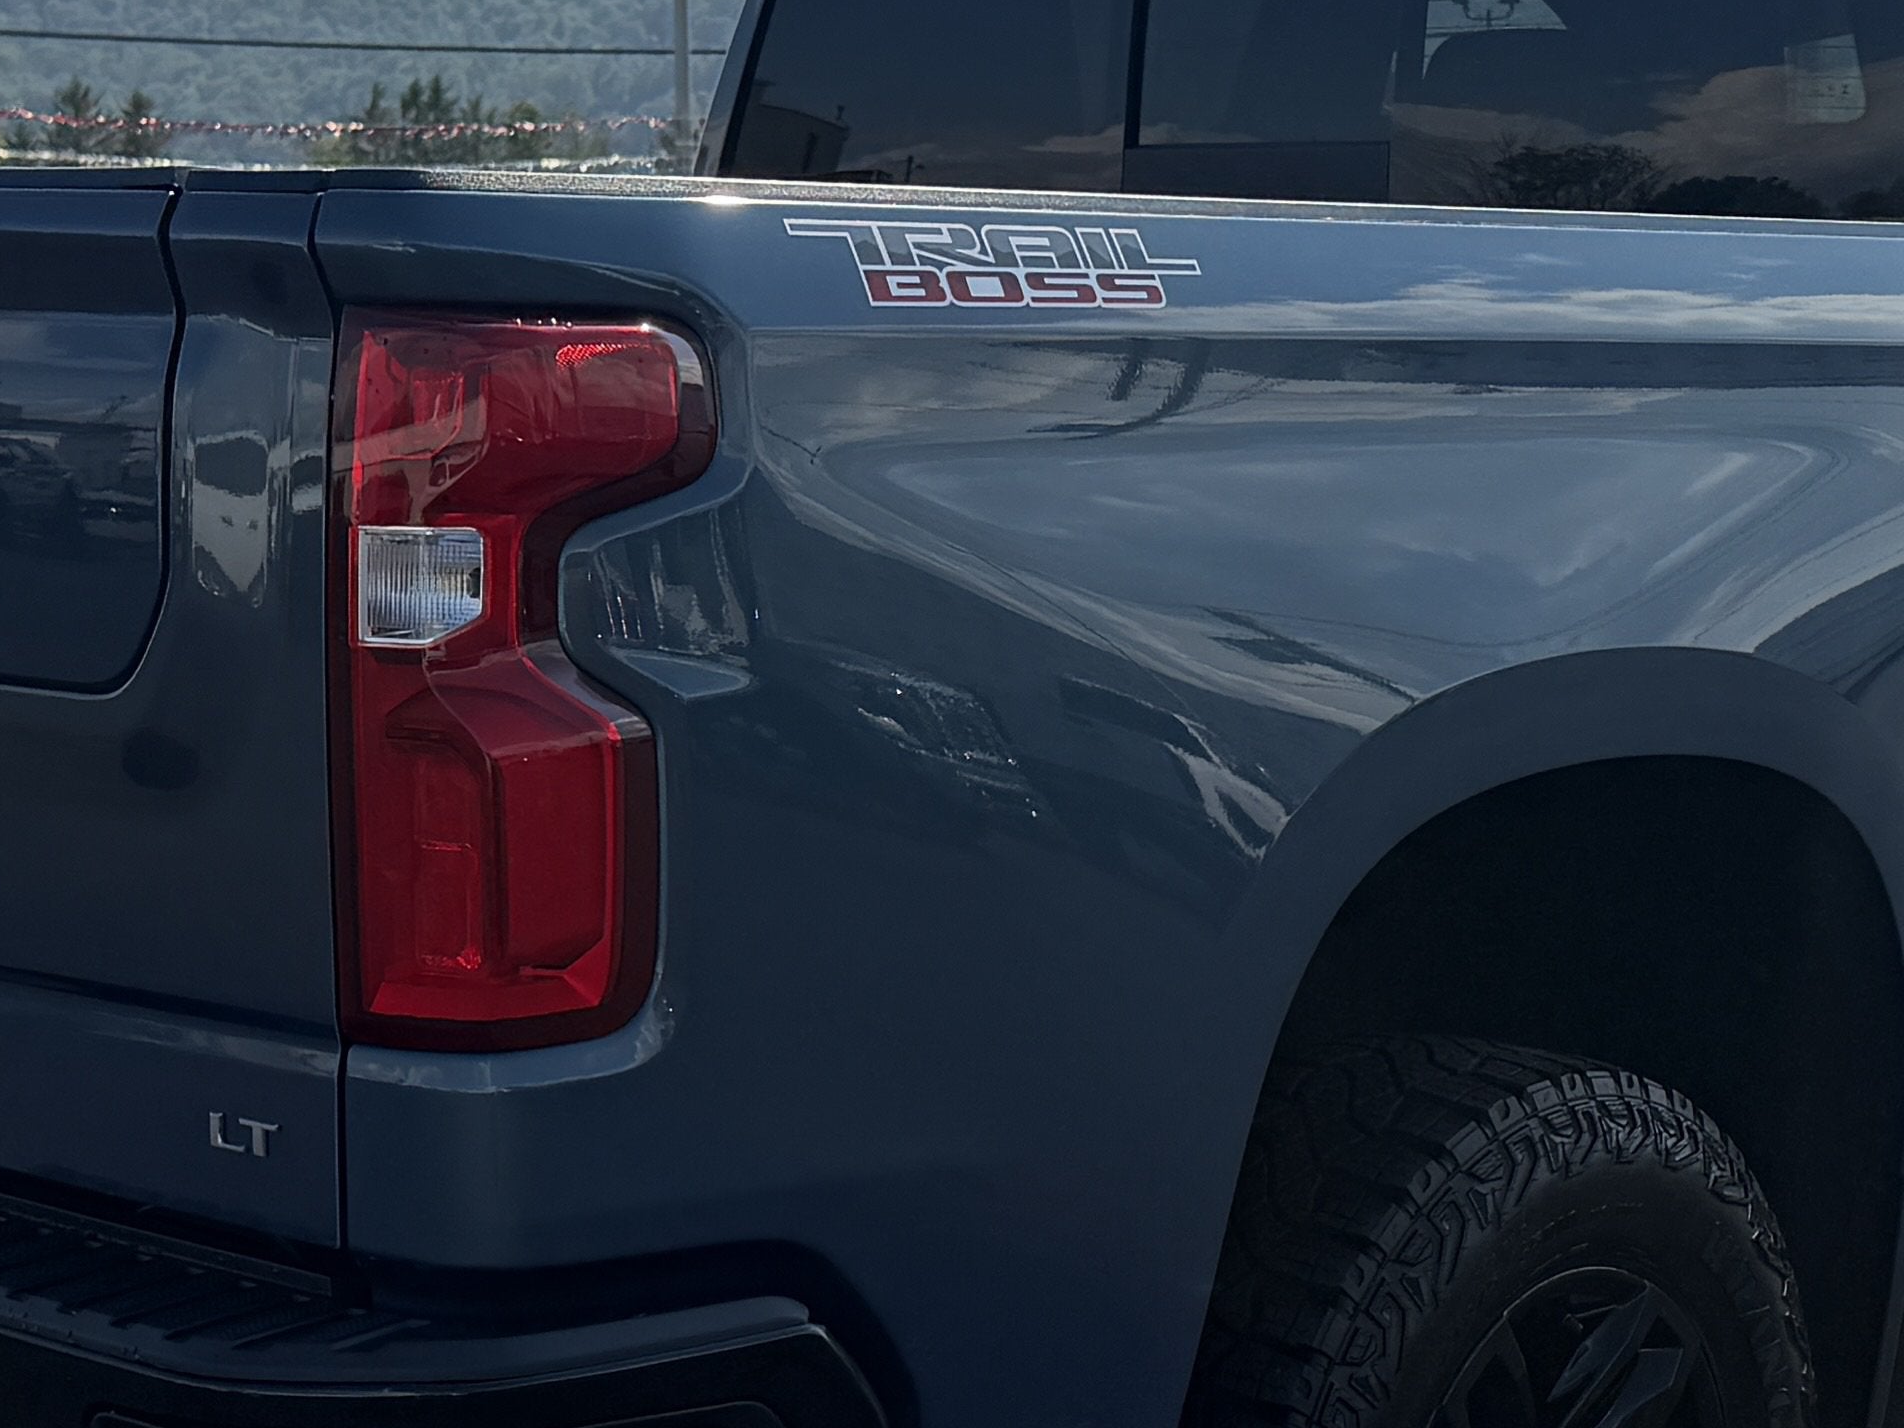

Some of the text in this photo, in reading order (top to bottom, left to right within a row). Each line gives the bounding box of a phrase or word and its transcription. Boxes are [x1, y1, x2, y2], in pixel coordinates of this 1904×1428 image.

[783, 218, 1202, 275] TRAIL
[860, 268, 1167, 309] BOSS
[209, 1112, 279, 1157] LT
